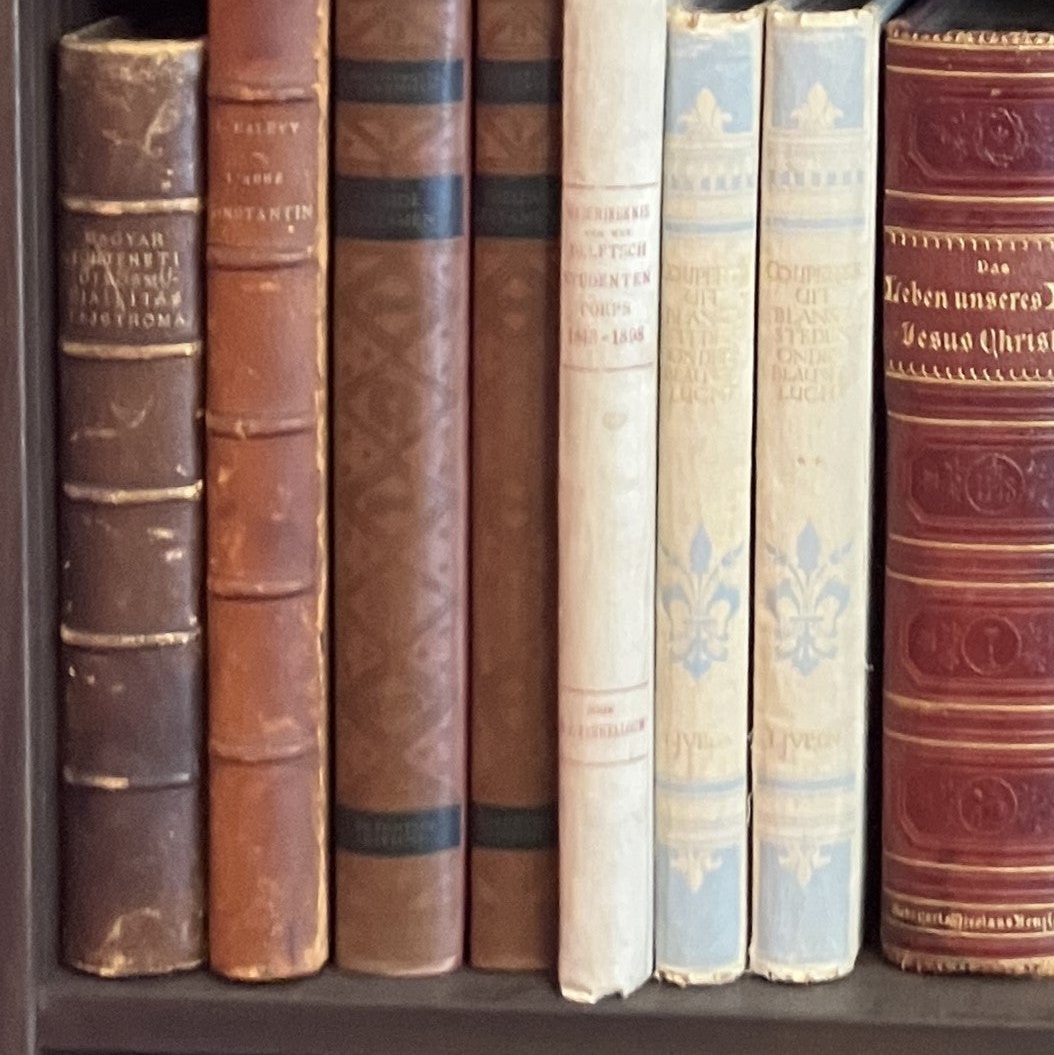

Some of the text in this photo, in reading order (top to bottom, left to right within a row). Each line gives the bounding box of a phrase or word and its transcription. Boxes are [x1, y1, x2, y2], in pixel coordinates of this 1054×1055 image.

[977, 259, 1011, 275] Das
[884, 274, 949, 309] Leben
[954, 289, 1043, 311] unseres
[901, 321, 974, 353] Jesus
